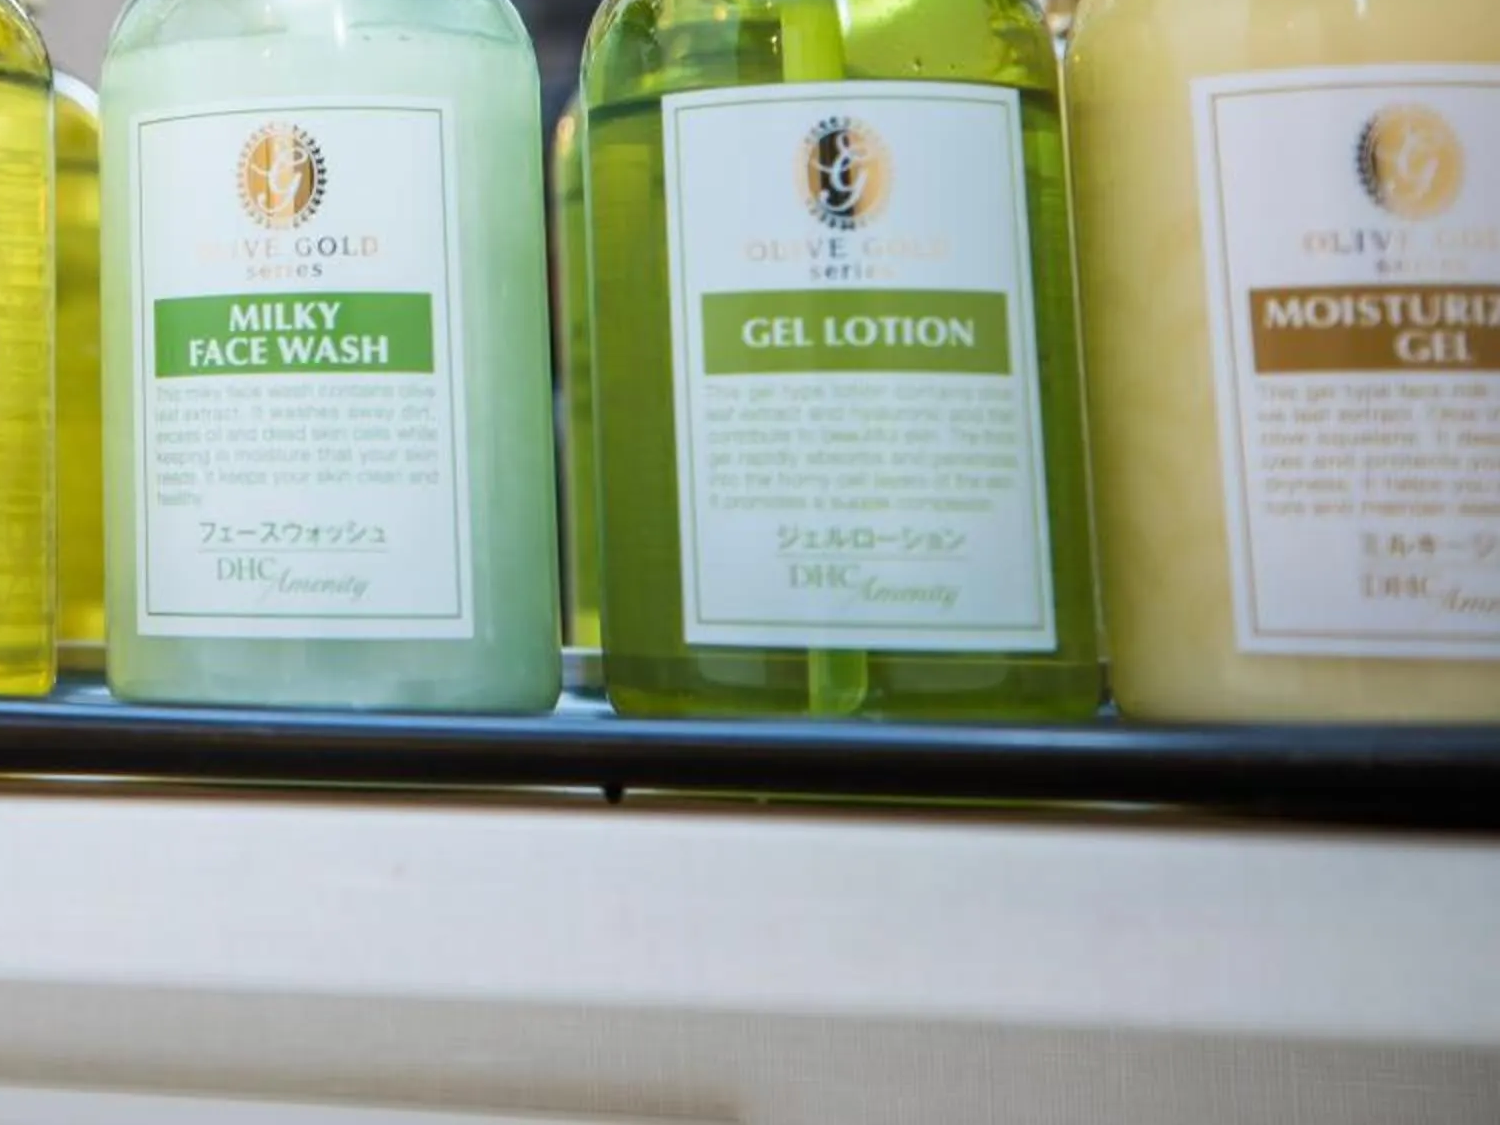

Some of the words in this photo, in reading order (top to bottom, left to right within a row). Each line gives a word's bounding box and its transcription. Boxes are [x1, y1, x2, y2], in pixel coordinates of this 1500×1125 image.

[293, 235, 380, 258] GOLD
[245, 262, 325, 280] series
[228, 300, 344, 332] MILKY
[740, 315, 816, 349] GEL
[822, 315, 976, 348] LOTION
[189, 335, 270, 367] FACE
[275, 334, 390, 365] WASH
[1393, 330, 1476, 364] GEL
[197, 520, 387, 545] フェースウォッシュ
[215, 555, 278, 581] DHC
[262, 566, 370, 603] Amenity
[788, 563, 861, 589] DHC
